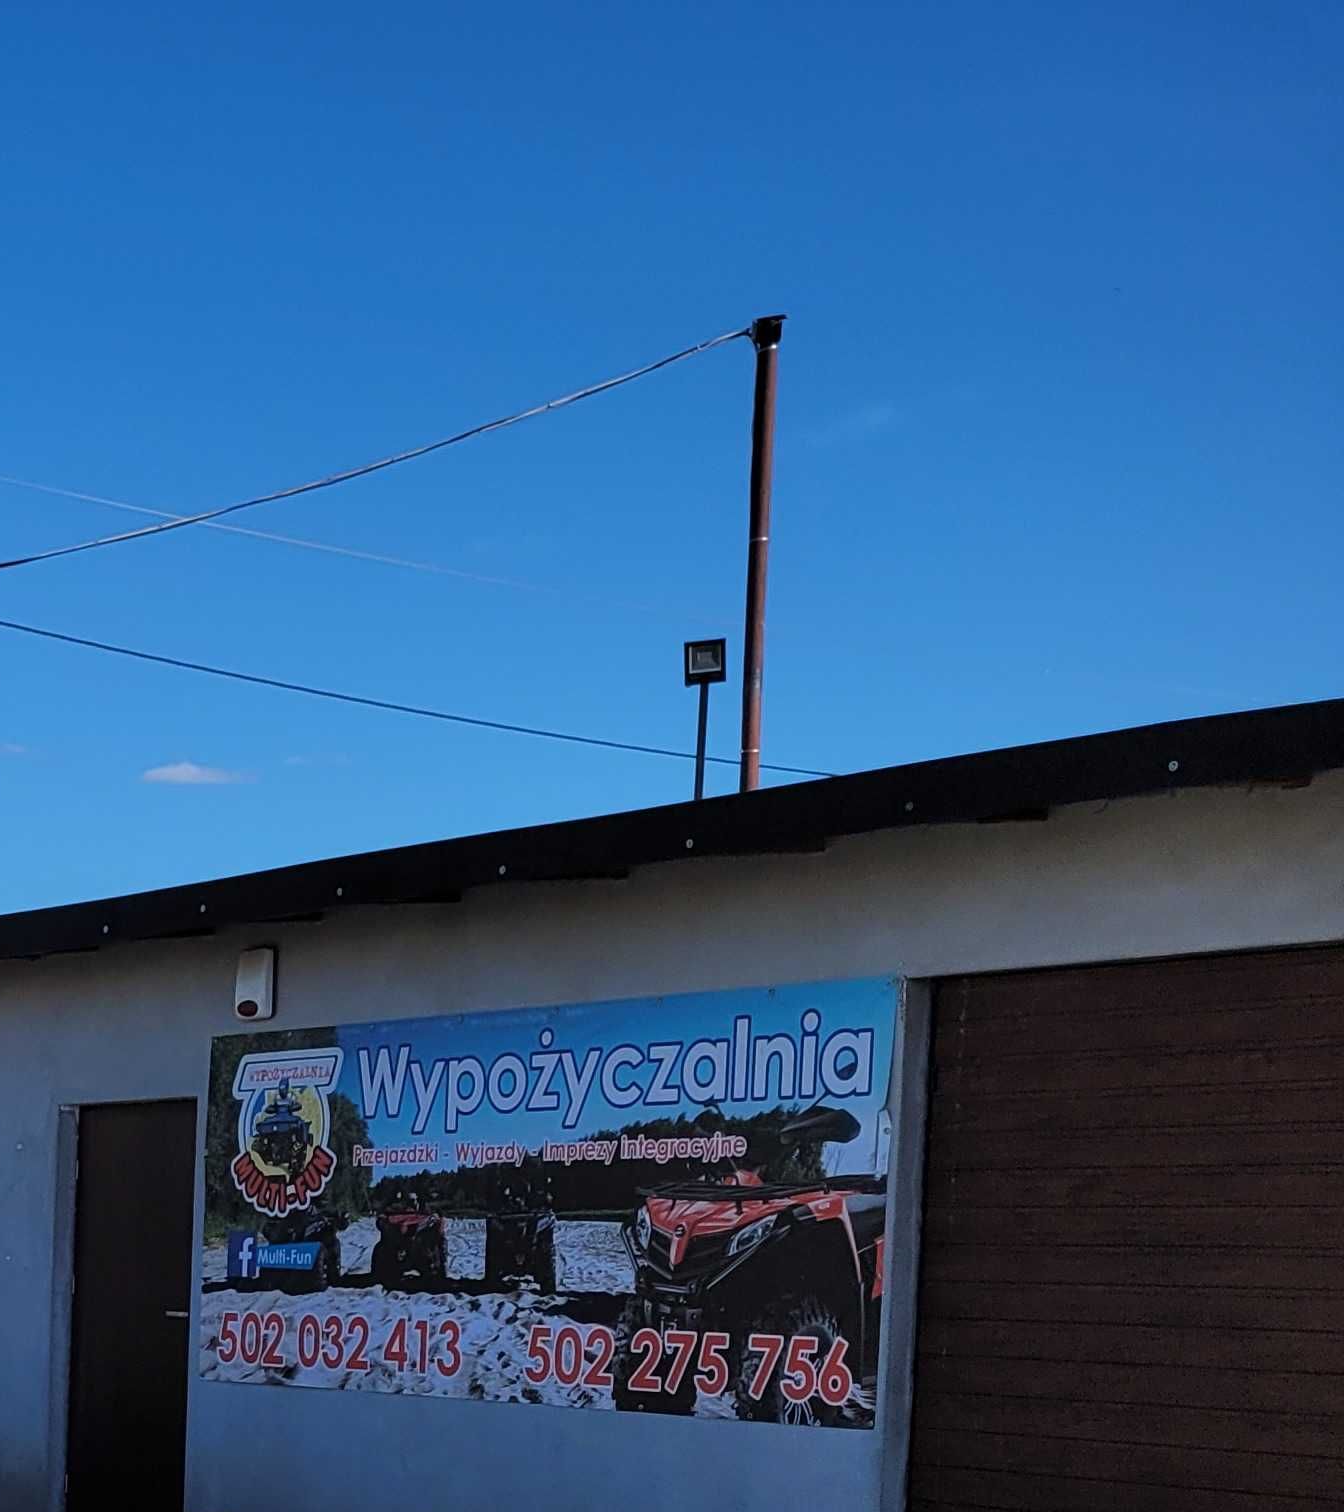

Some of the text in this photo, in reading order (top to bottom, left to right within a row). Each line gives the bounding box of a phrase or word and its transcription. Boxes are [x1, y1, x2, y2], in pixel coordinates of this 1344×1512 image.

[357, 1008, 874, 1134] Wypożyczalnia
[455, 1140, 526, 1167] Wyjazdy
[543, 1136, 617, 1164] Imprezy
[620, 1134, 746, 1162] integracyjne
[257, 1248, 313, 1266] Multi-Fun
[217, 1312, 463, 1377] 502 032 413
[523, 1325, 853, 1405] 502 275 756
